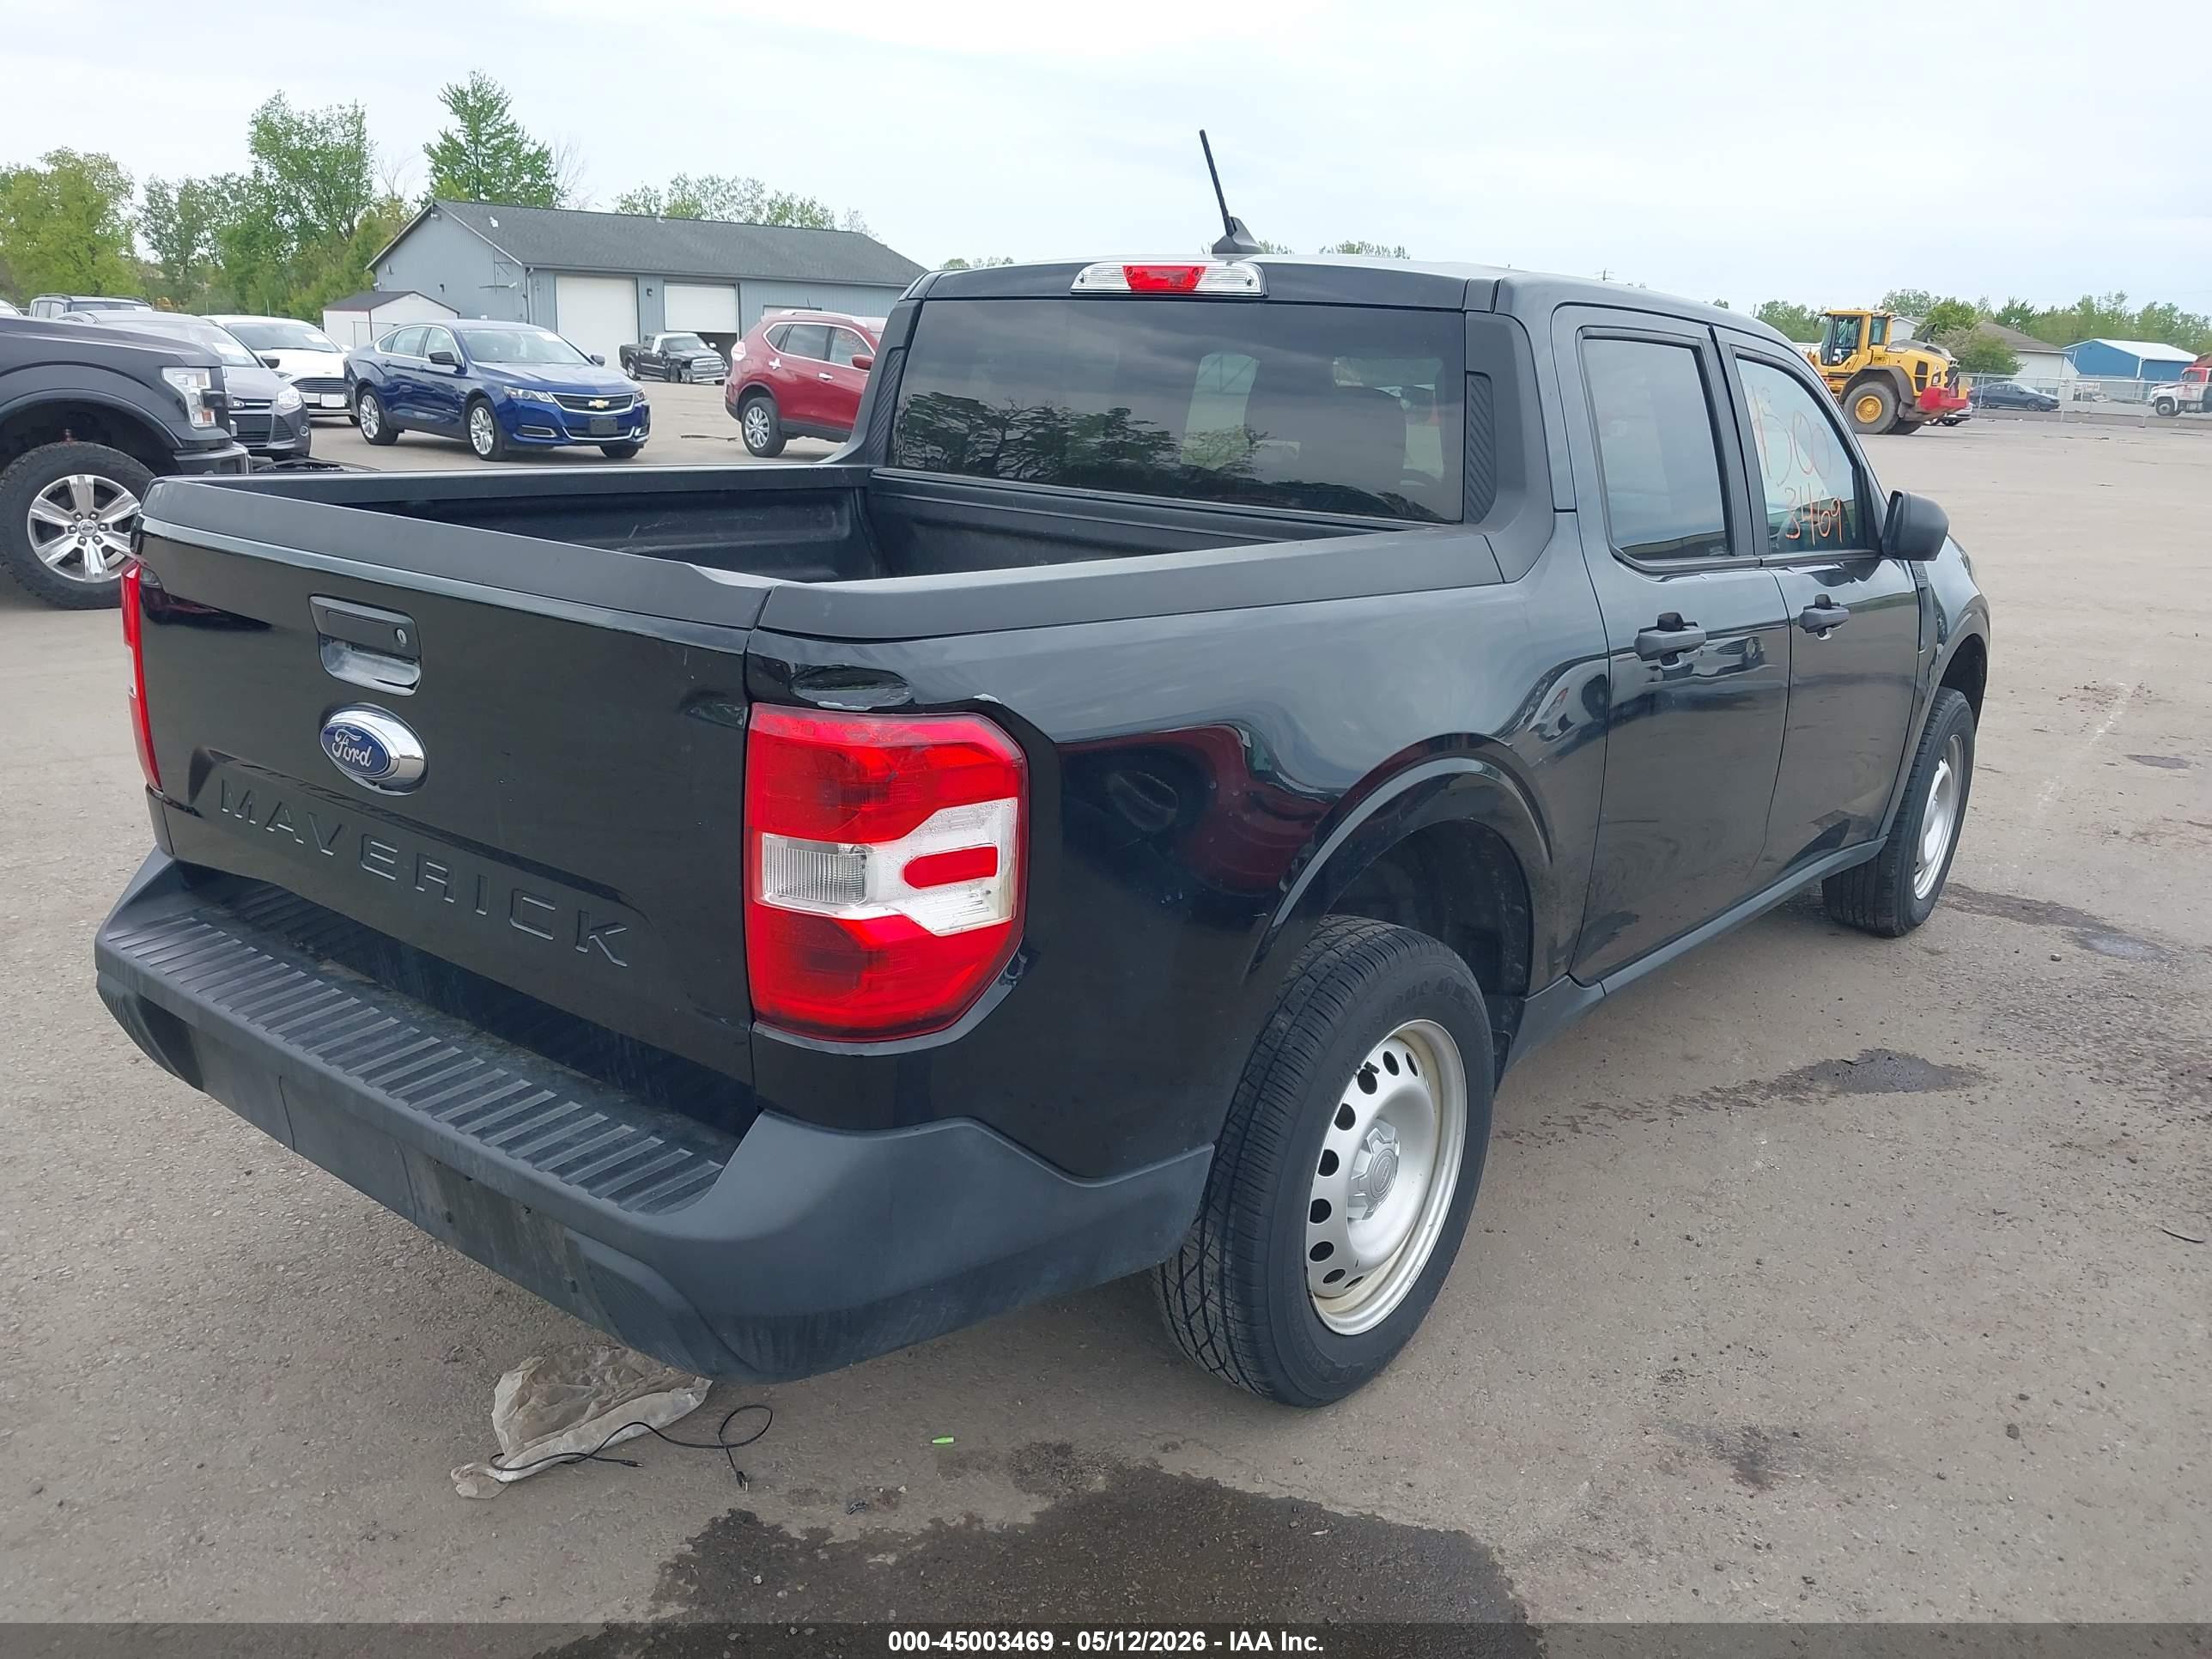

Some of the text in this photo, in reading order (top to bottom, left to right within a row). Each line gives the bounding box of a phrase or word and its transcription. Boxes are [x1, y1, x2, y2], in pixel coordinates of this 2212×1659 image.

[1784, 481, 1843, 547] 3469
[331, 728, 373, 767] Ford
[220, 778, 628, 968] MAVERICK
